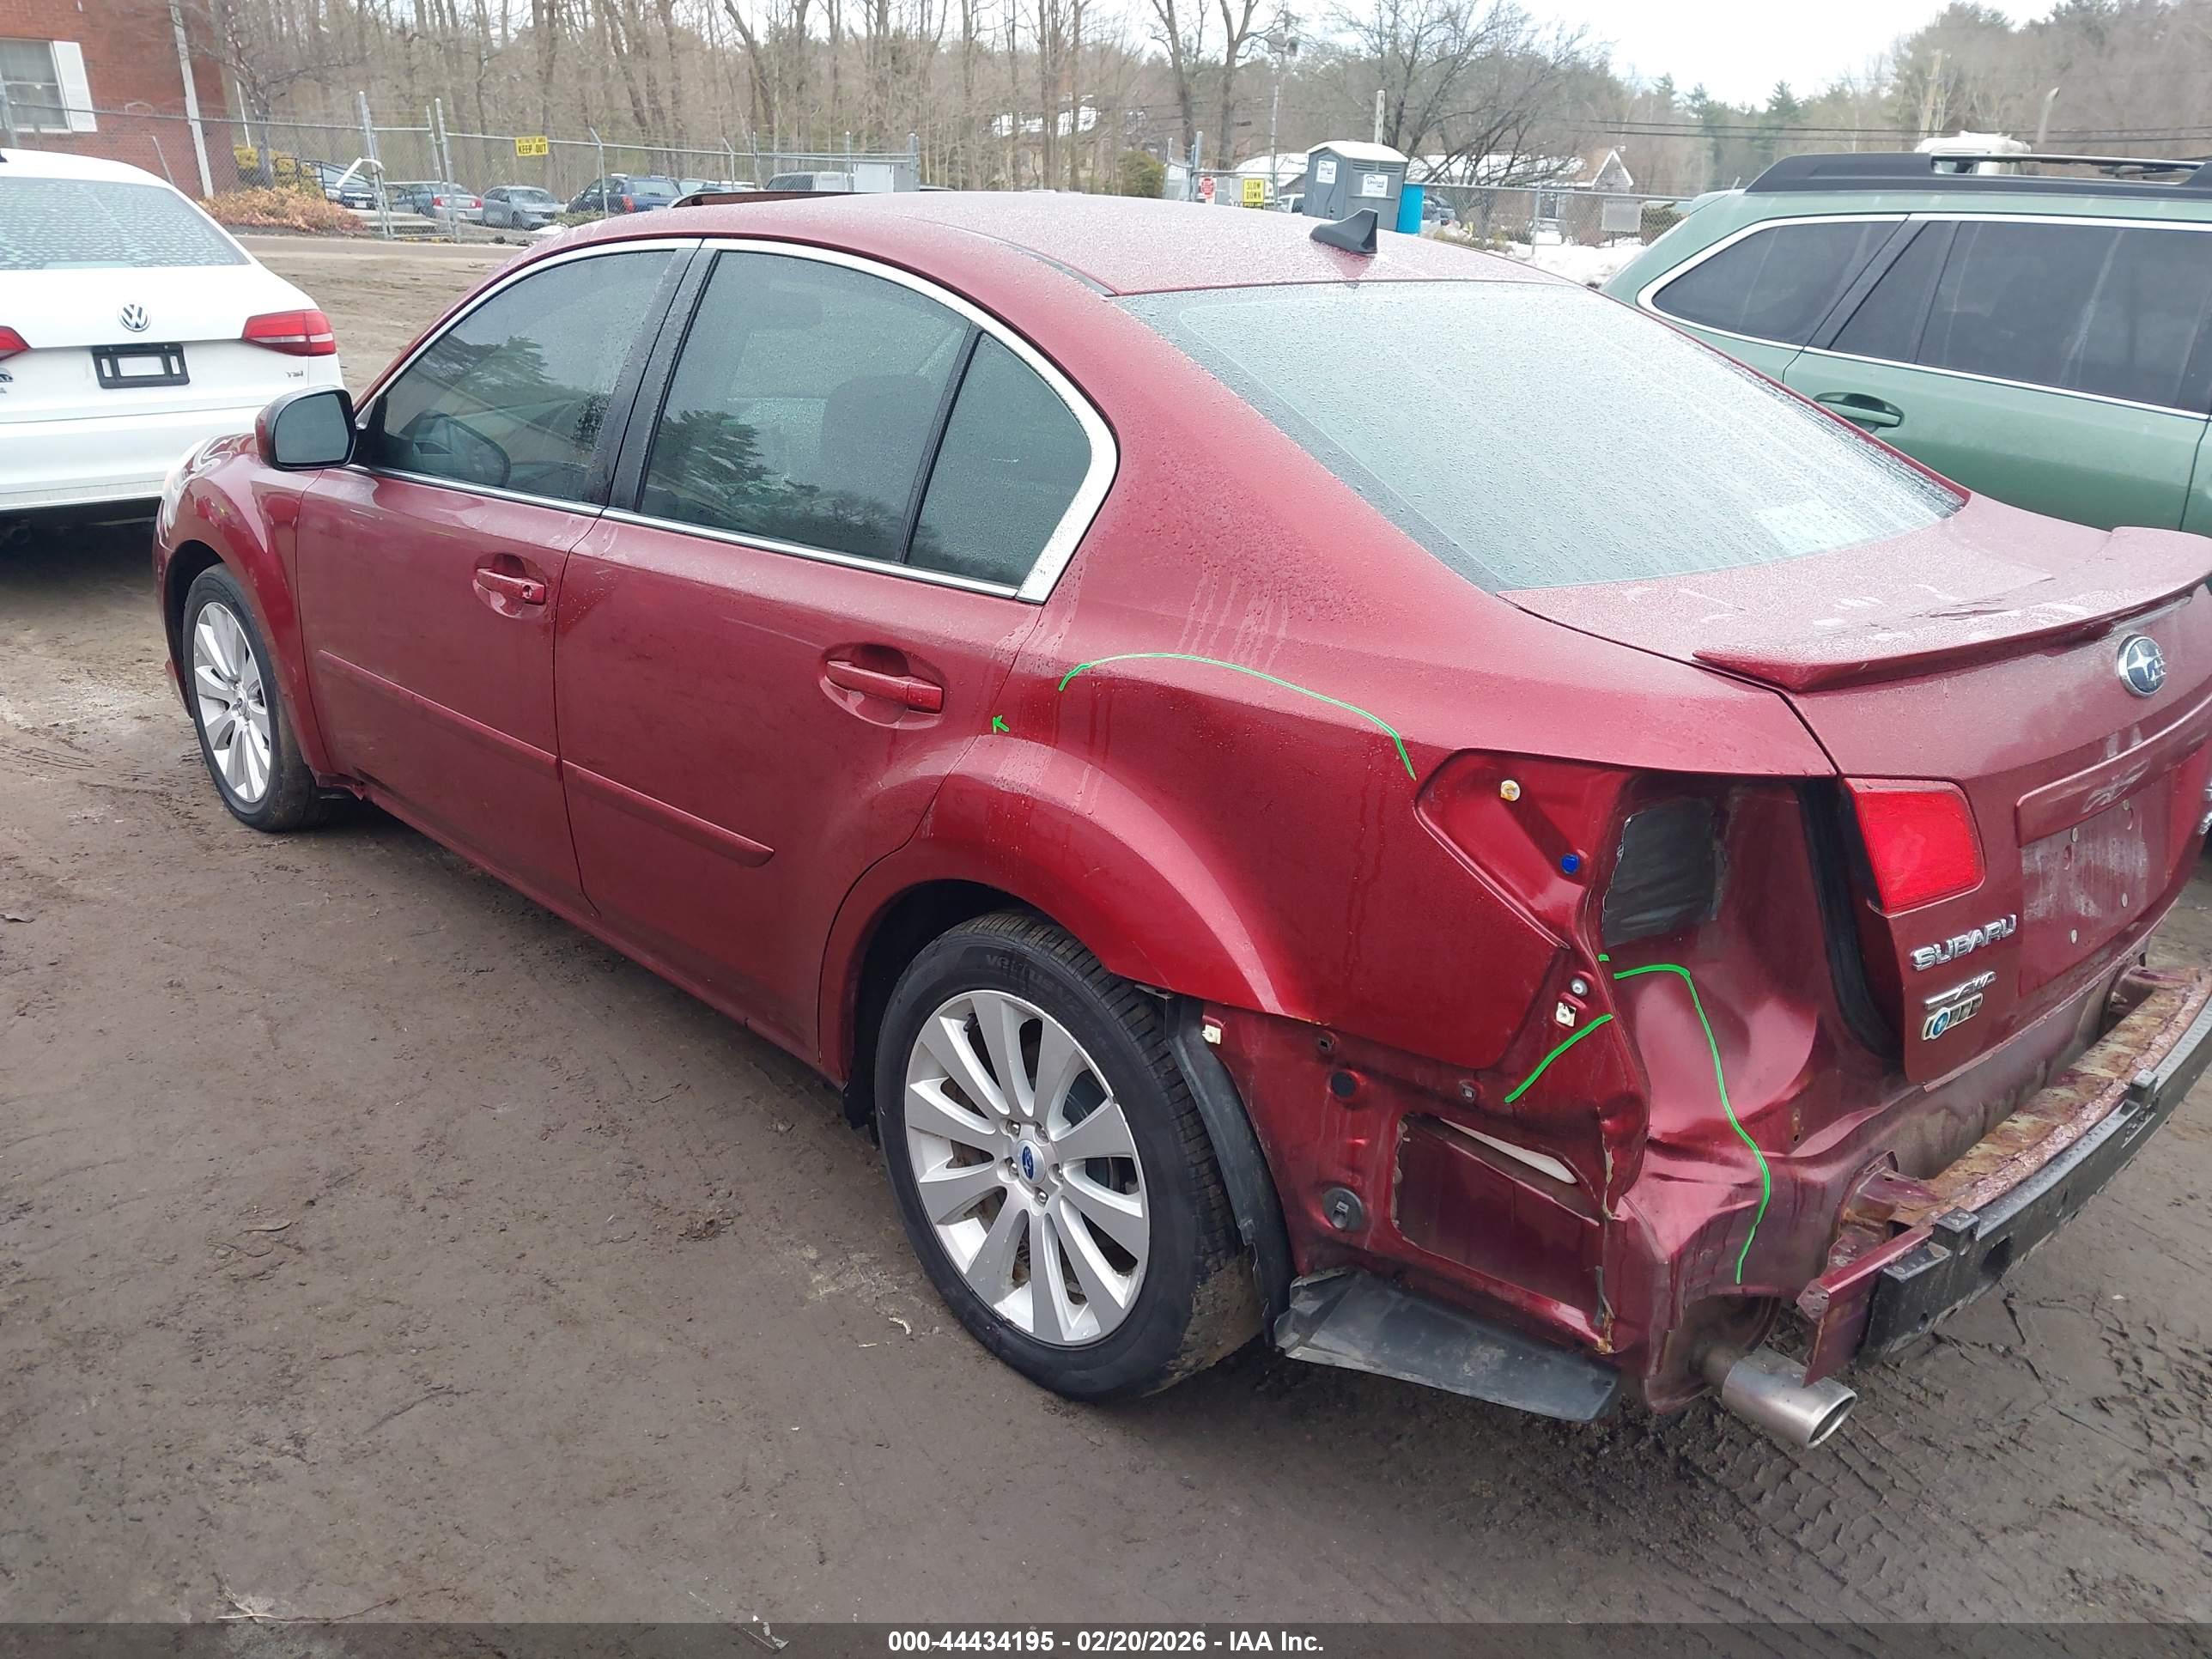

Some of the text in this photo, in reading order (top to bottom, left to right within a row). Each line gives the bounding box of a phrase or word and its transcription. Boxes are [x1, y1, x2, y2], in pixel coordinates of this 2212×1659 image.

[518, 143, 546, 155] KEEP OUT
[1247, 181, 1261, 190] SLOW
[1246, 191, 1261, 199] DOWN
[1911, 914, 2017, 971] SUBARU
